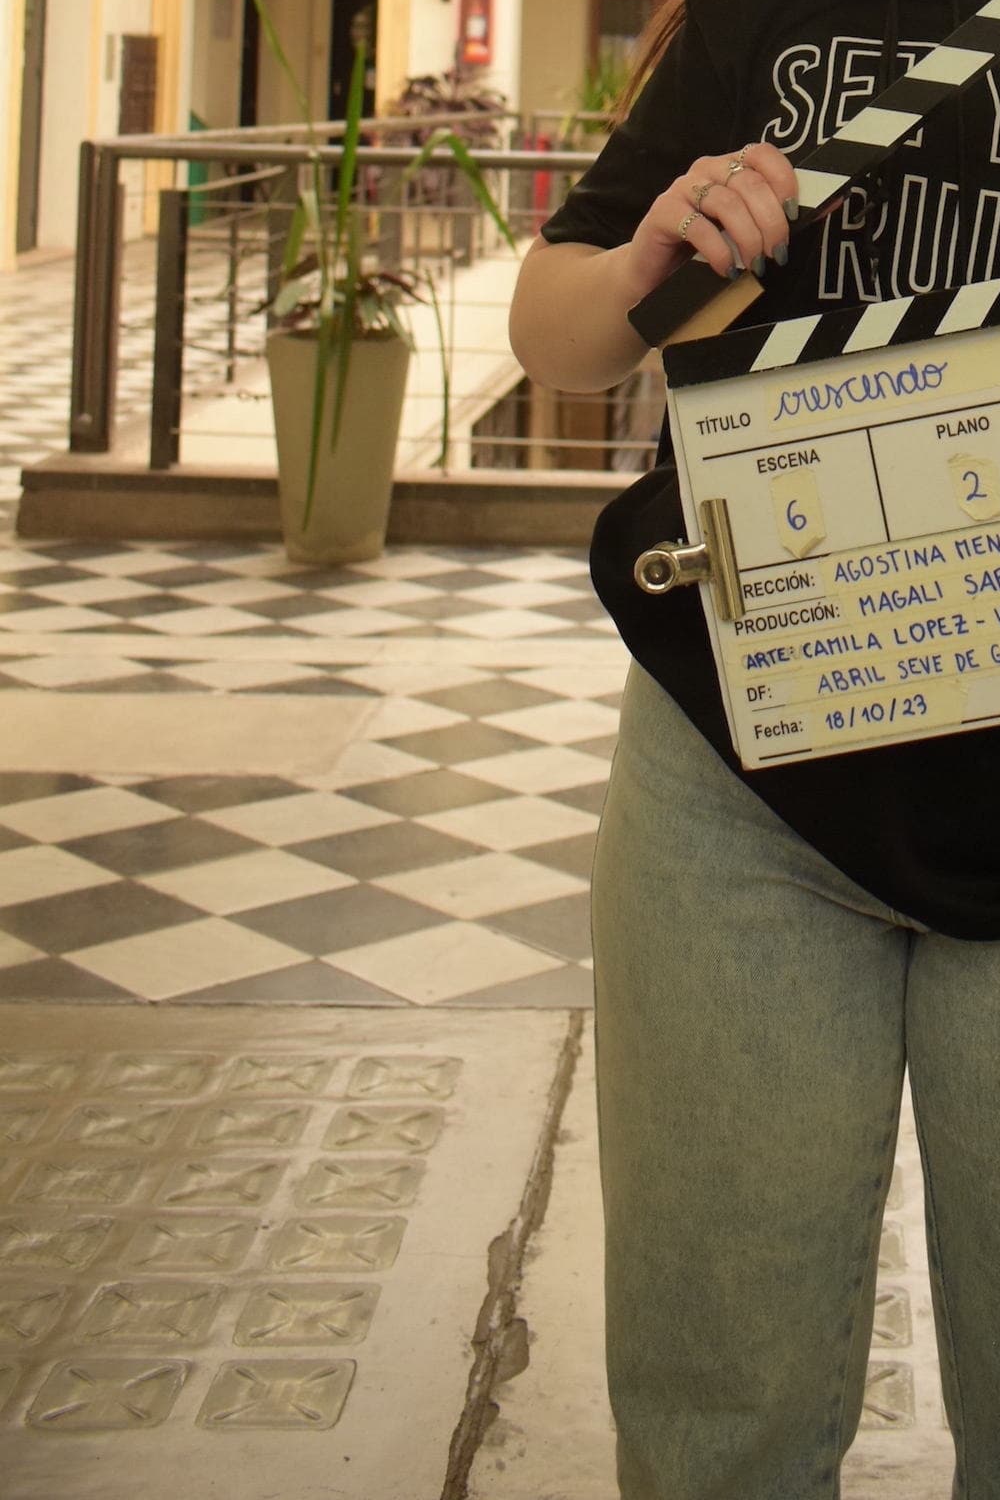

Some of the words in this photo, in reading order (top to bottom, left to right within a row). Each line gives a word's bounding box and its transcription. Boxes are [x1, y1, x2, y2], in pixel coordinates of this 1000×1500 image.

[773, 361, 948, 421] crescendo
[696, 412, 751, 436] TÍTULO
[936, 416, 990, 439] PLANO
[756, 449, 821, 474] ESCENA
[962, 471, 988, 501] 2
[786, 500, 808, 531] 6
[834, 544, 947, 583] AGOSTINA
[742, 570, 816, 600] RECCIÓN:
[858, 580, 944, 616] MAGALI
[734, 601, 841, 637] PRODUCCIÓN:
[746, 645, 795, 671] ARTE:
[802, 632, 883, 659] CAMILA
[893, 613, 970, 645] LOPEZ
[818, 665, 886, 695] ABRIL
[897, 653, 943, 680] SEVE
[955, 649, 981, 674] DE
[746, 684, 773, 702] DF:
[825, 693, 928, 731] 18/10/23
[754, 719, 805, 740] Fecha:
